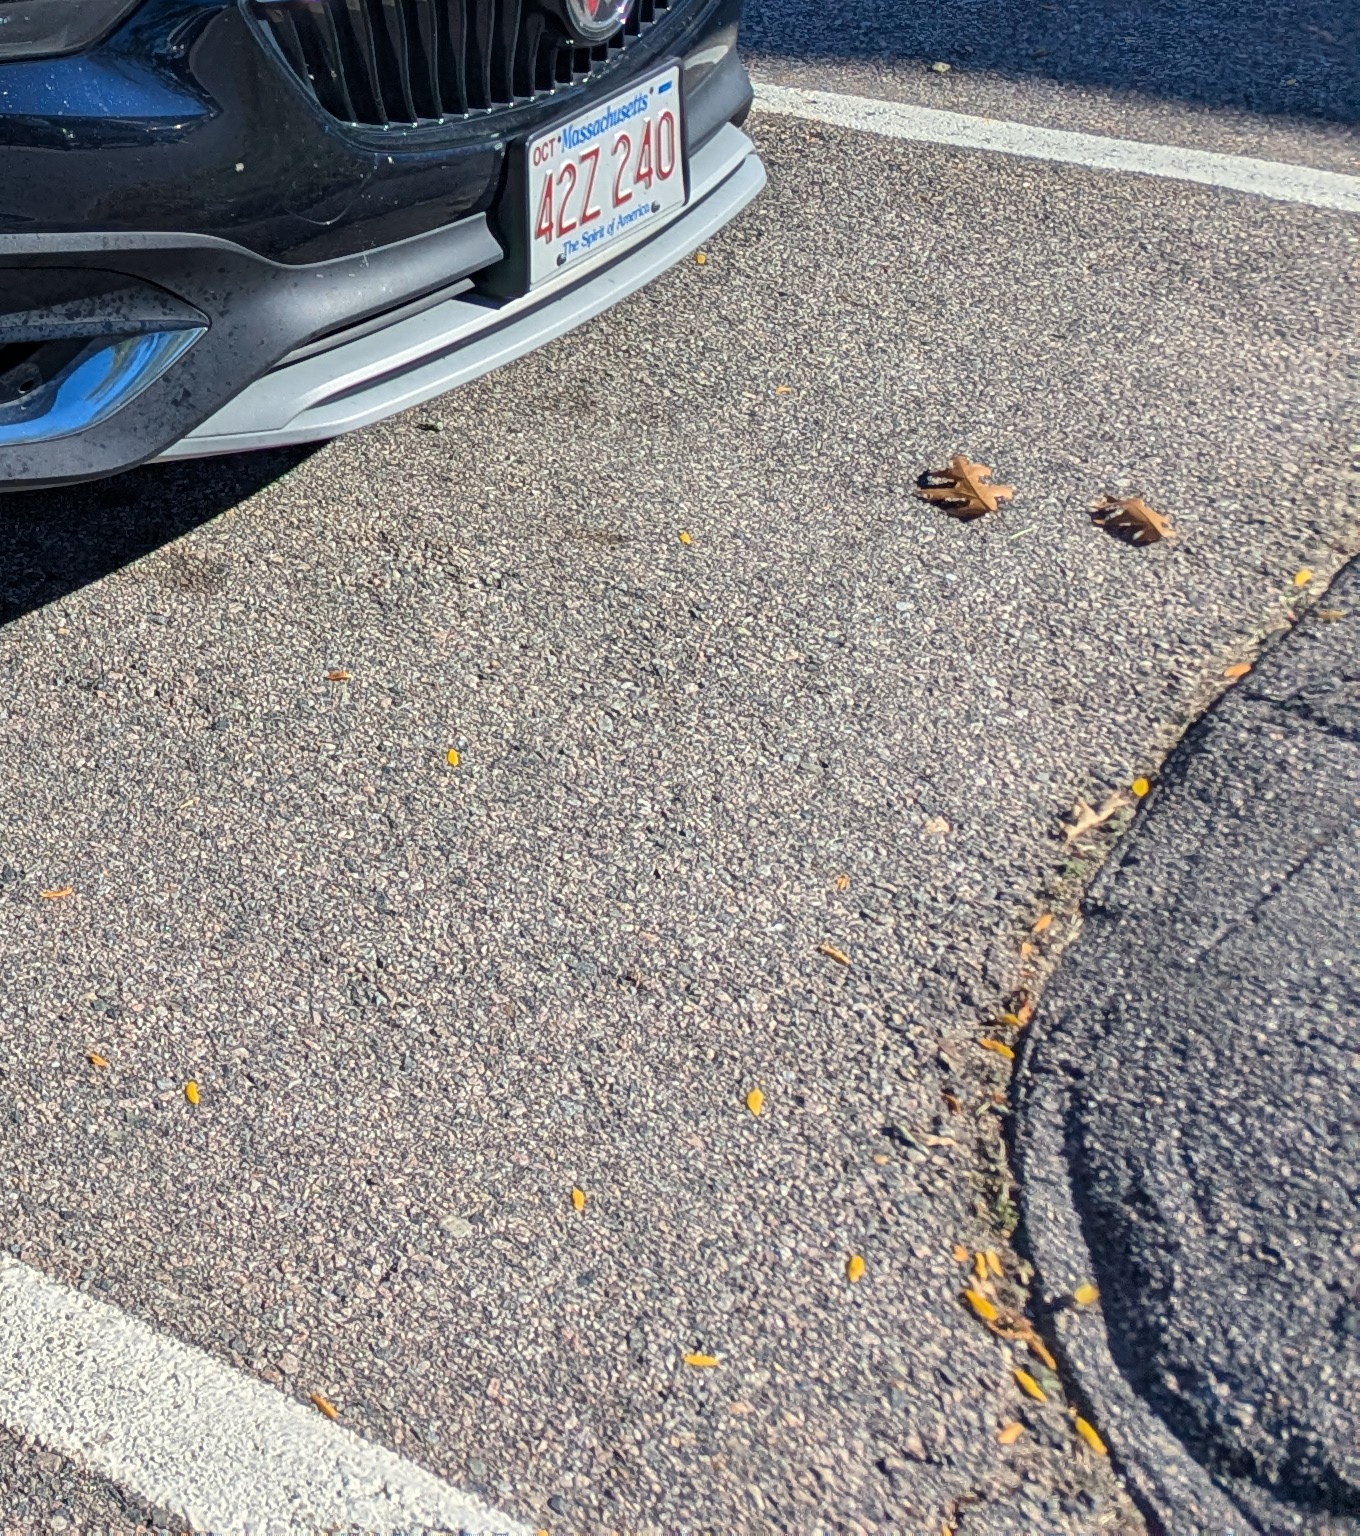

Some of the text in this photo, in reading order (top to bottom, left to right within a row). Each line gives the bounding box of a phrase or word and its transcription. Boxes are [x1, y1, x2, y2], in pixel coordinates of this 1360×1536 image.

[532, 93, 649, 166] OCT Massachusetts
[534, 110, 676, 244] 42Z 240
[561, 203, 650, 257] The Spirit of America
